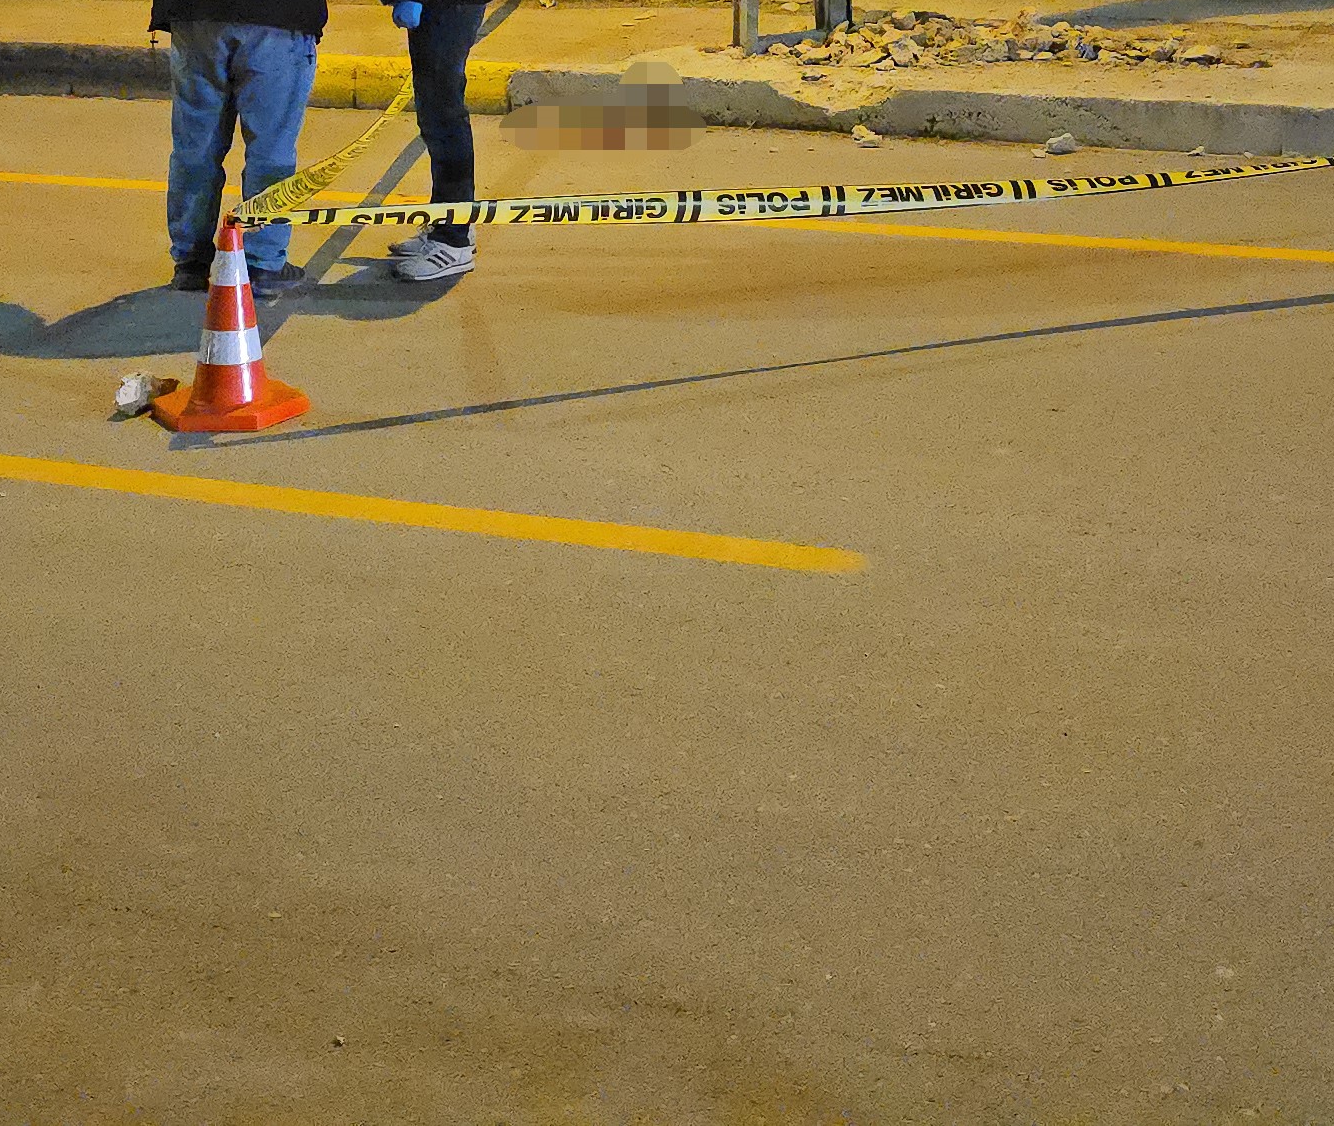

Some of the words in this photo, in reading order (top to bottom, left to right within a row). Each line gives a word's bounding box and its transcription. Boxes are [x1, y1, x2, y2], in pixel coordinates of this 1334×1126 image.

[717, 190, 811, 215] POLİS
[856, 182, 1004, 207] GİRİLMEZ
[509, 197, 668, 224] GİRİLMEZ
